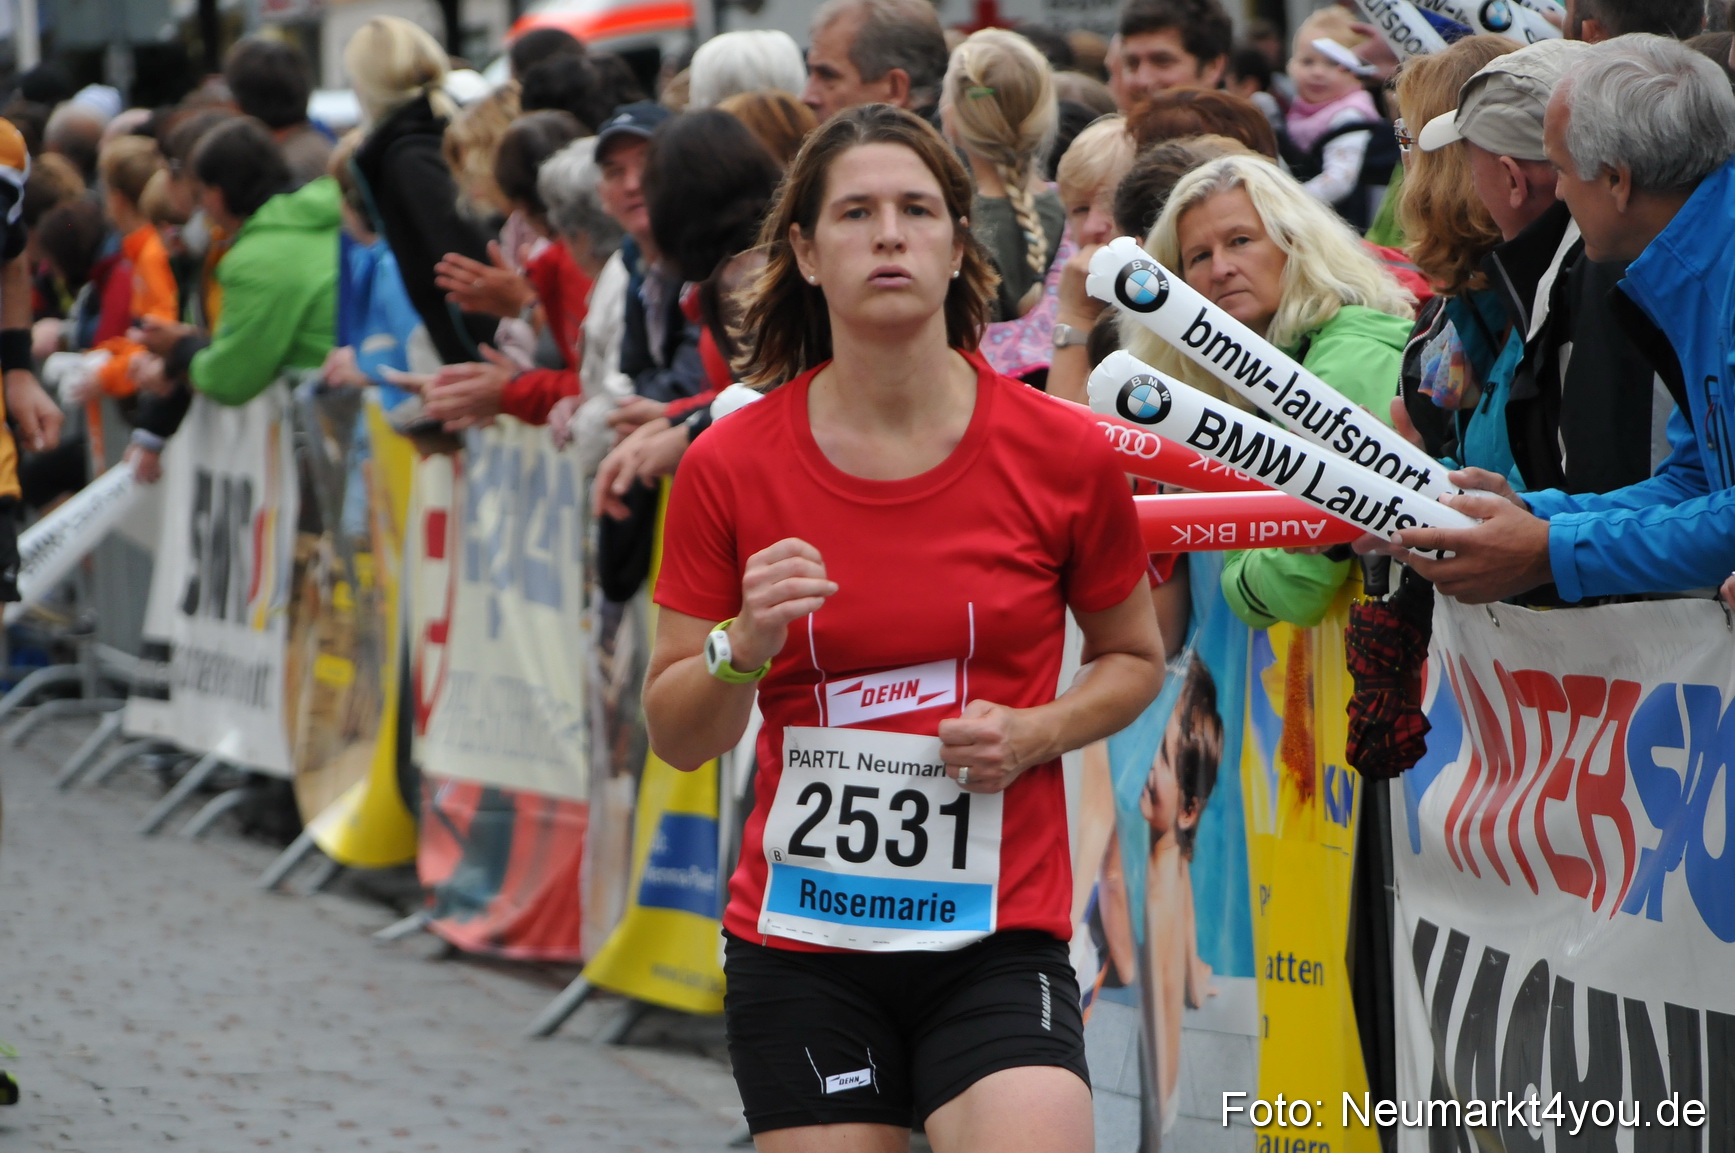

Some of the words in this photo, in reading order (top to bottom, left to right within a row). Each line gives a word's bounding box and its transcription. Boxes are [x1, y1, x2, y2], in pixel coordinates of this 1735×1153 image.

[1131, 260, 1169, 291] BMW
[1131, 376, 1171, 402] BMW
[1181, 306, 1464, 501] bmw-laufsport
[1186, 407, 1308, 486] BMW
[1301, 460, 1447, 560] Laufs
[1171, 523, 1237, 546] BKK
[1250, 519, 1328, 542] Audi
[860, 678, 921, 708] DEHN
[788, 749, 850, 770] PARTL
[787, 781, 971, 870] 2531
[800, 878, 956, 924] Rosemarie
[839, 1075, 860, 1086] DEHN
[1256, 1133, 1331, 1153] auern
